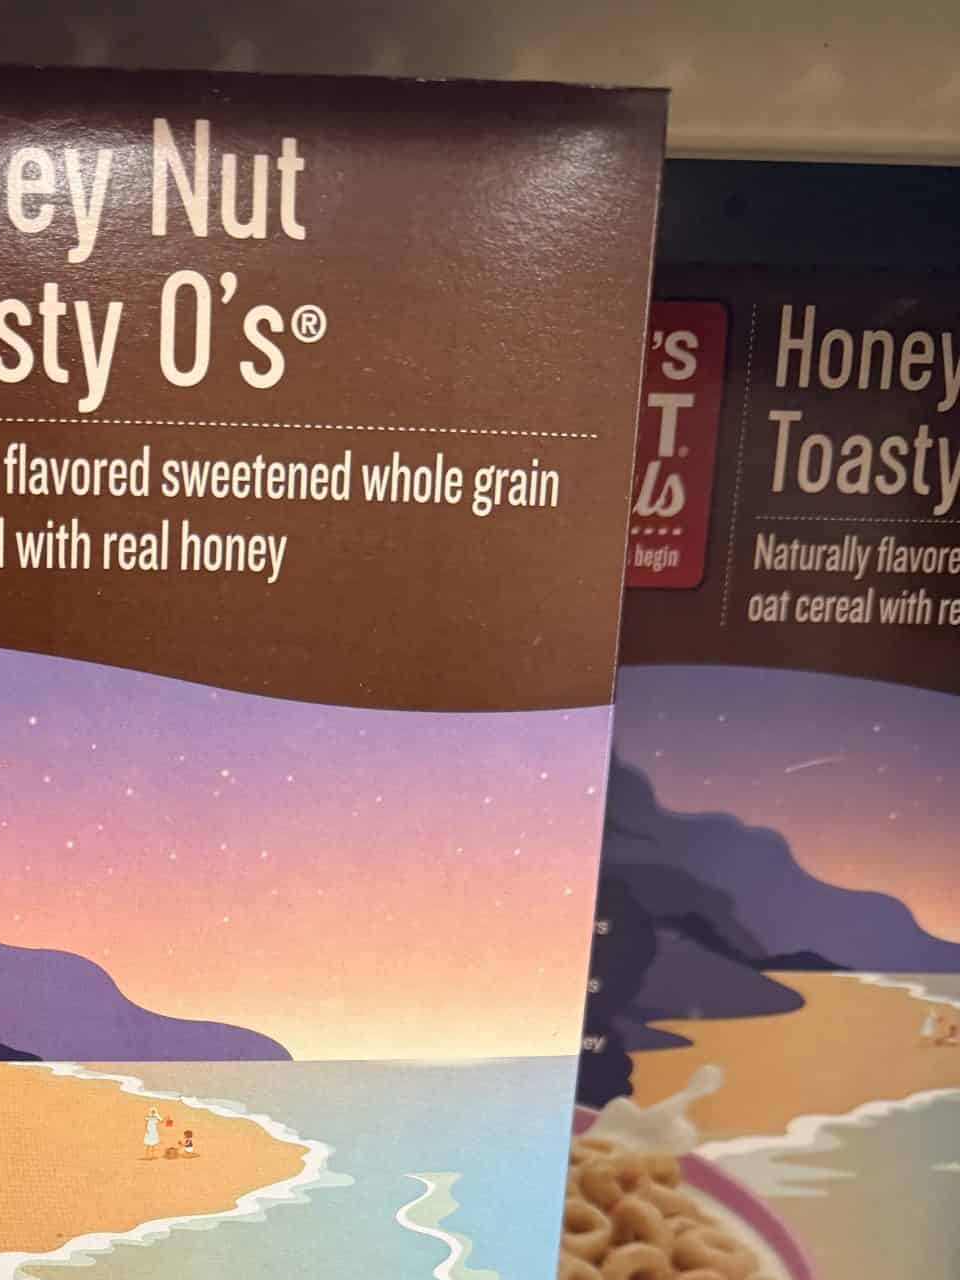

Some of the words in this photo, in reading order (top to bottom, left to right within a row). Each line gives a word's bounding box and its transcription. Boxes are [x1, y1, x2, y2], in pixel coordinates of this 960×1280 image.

[152, 118, 306, 240] Nut
[775, 305, 960, 412] Honey
[4, 445, 151, 499] flavored
[161, 450, 351, 502] sweetened
[361, 453, 464, 505] whole
[472, 460, 560, 517] grain
[768, 410, 960, 516] Toasty
[15, 520, 93, 570] with
[102, 520, 169, 571] real
[180, 522, 288, 584] honey
[634, 544, 679, 572] begin
[753, 532, 870, 580] Naturally
[748, 590, 791, 622] oat
[795, 588, 874, 624] cereal
[879, 588, 932, 624] with
